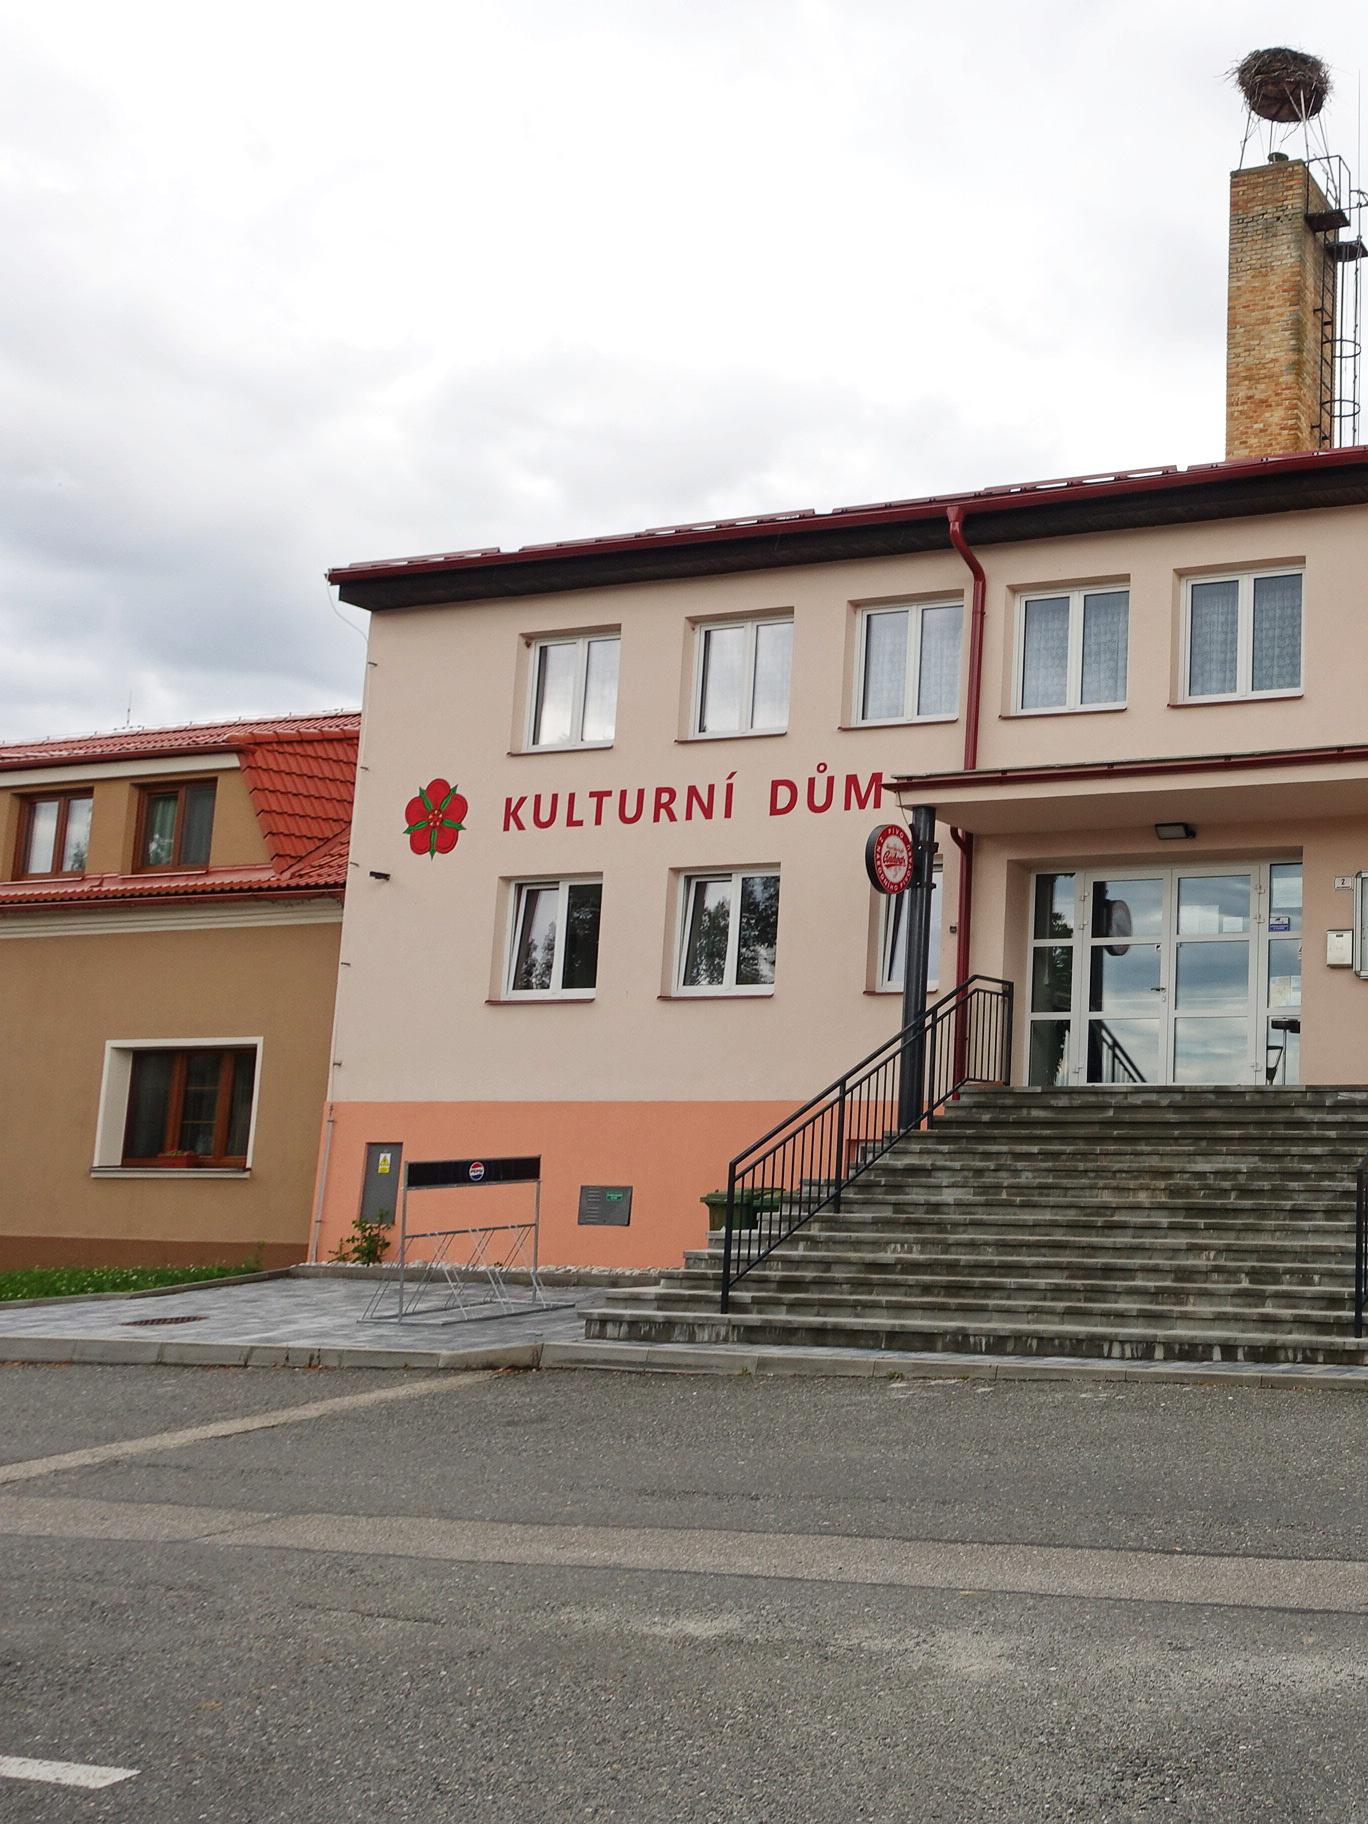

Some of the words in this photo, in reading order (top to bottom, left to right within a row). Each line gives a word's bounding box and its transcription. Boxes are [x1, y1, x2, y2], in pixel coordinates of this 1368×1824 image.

[502, 771, 737, 832] KULTURNÍ
[769, 762, 883, 816] DŮM
[888, 827, 904, 838] PIVO
